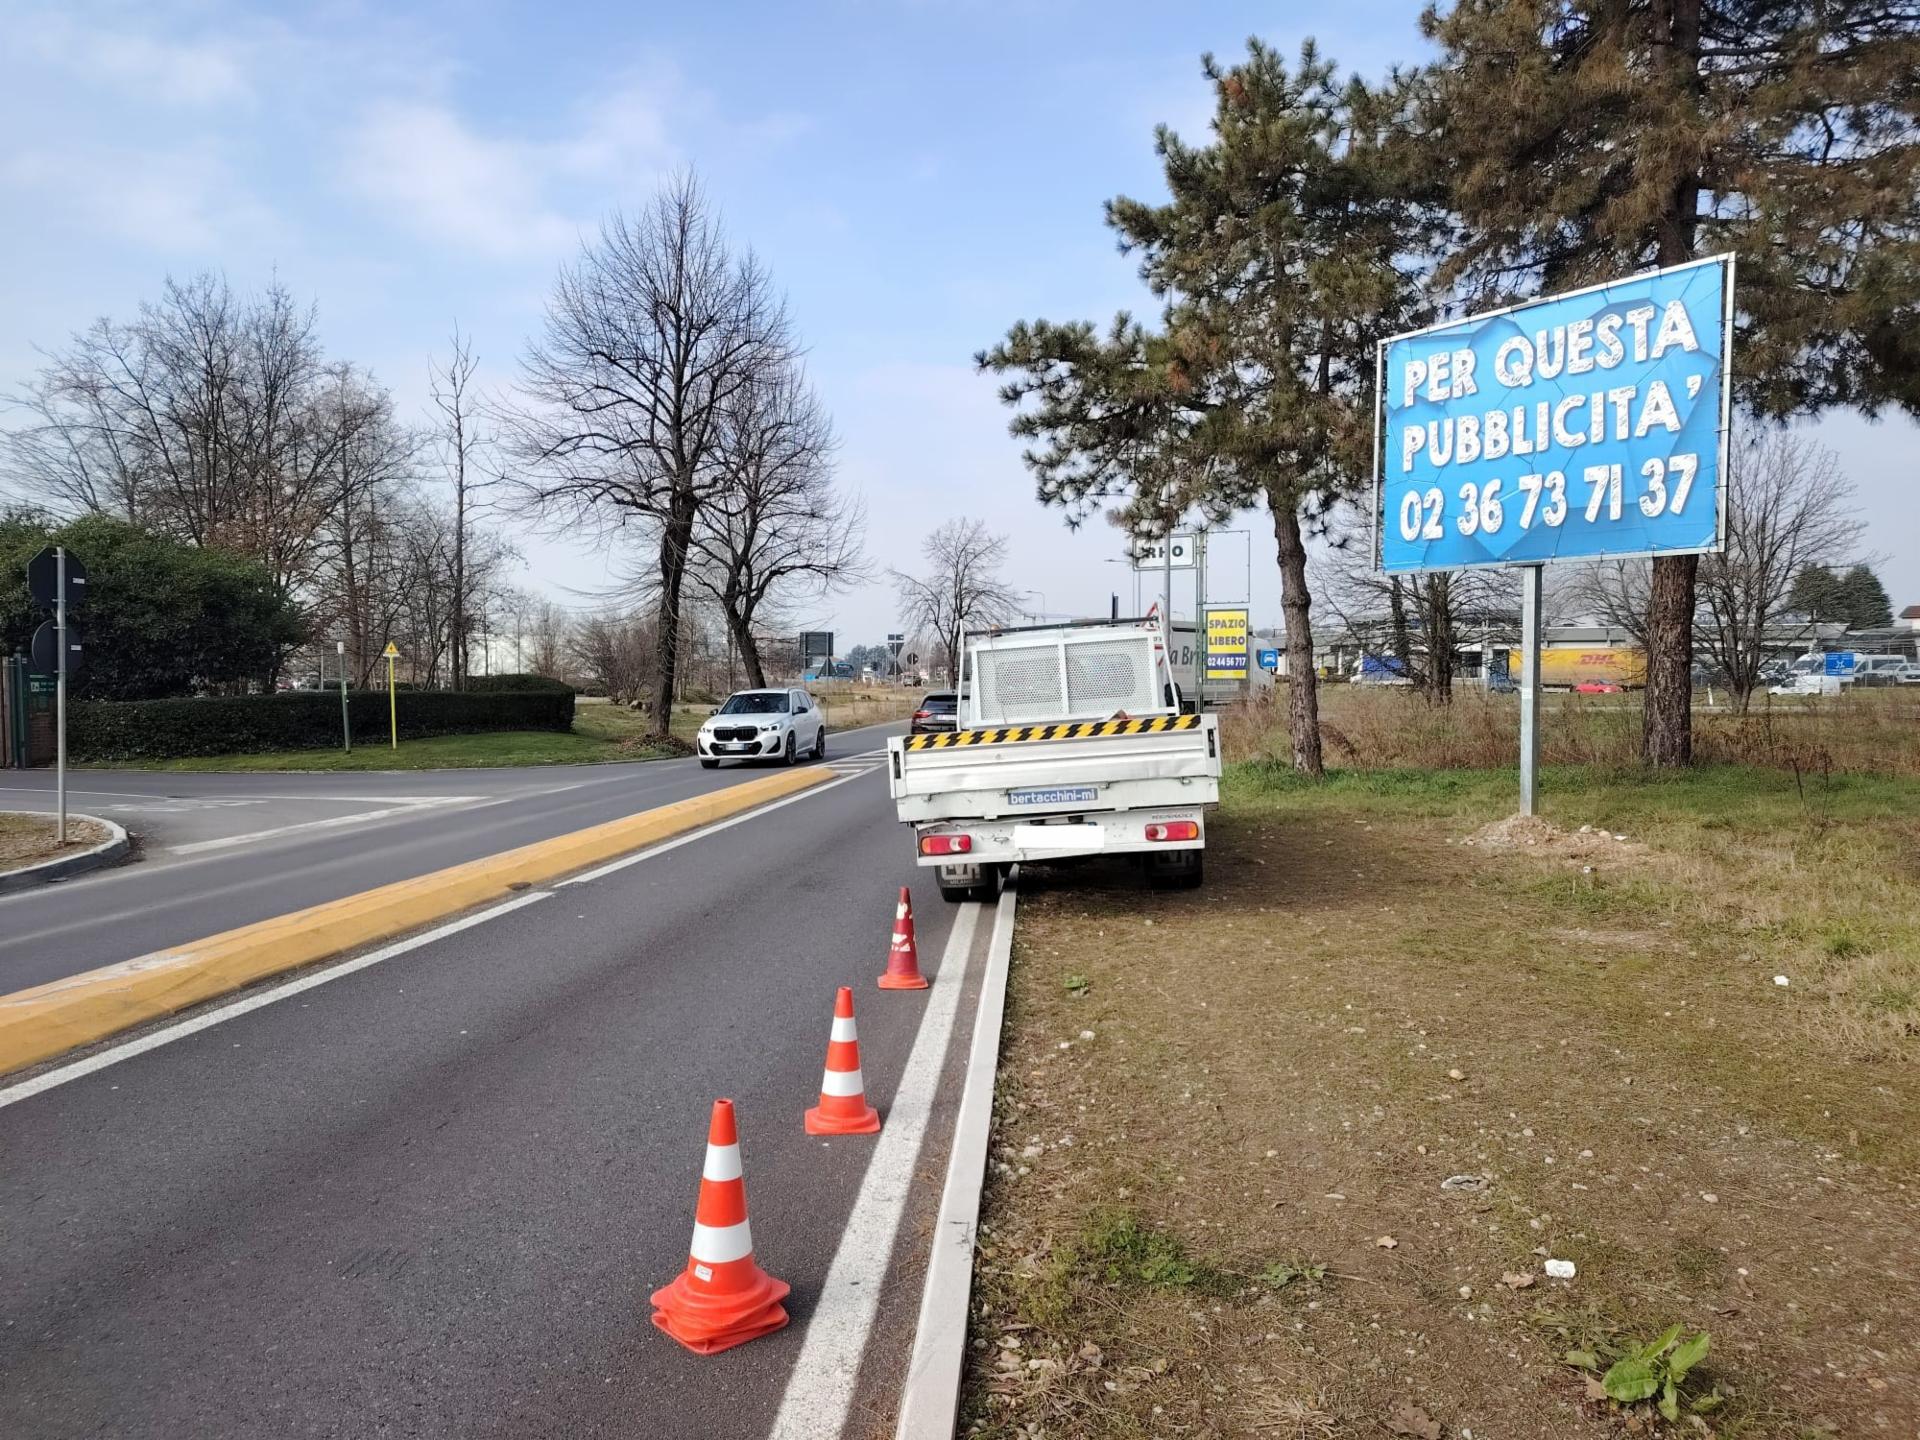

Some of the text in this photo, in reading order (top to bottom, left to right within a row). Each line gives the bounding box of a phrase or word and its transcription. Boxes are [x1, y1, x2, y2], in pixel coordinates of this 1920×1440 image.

[1404, 300, 1699, 407] PER QUESTA
[1400, 453, 1698, 541] 02 36 73 71 37
[1208, 619, 1246, 629] SPAZIO
[1208, 636, 1246, 646] LIBERO
[1010, 789, 1095, 804] bertacchini-mi
